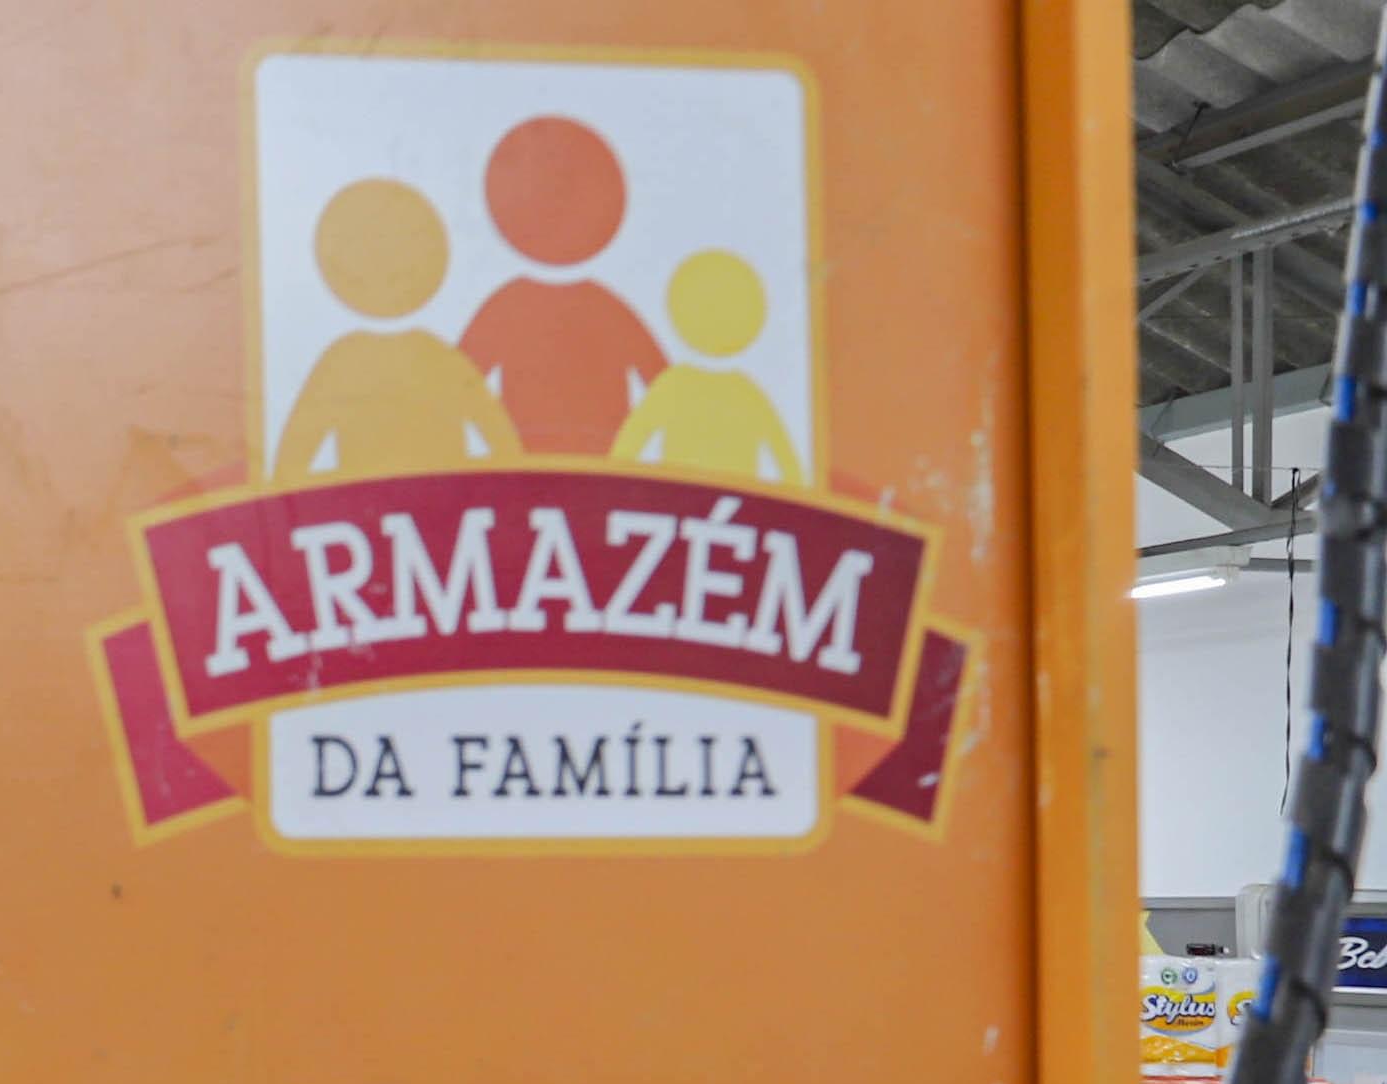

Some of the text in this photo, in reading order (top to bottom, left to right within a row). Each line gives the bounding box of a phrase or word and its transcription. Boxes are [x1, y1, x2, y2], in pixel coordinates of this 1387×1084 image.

[204, 495, 875, 678] ARMAZÉM
[309, 721, 779, 799] DA FAMÍLIA
[1141, 994, 1215, 1024] Stylus
